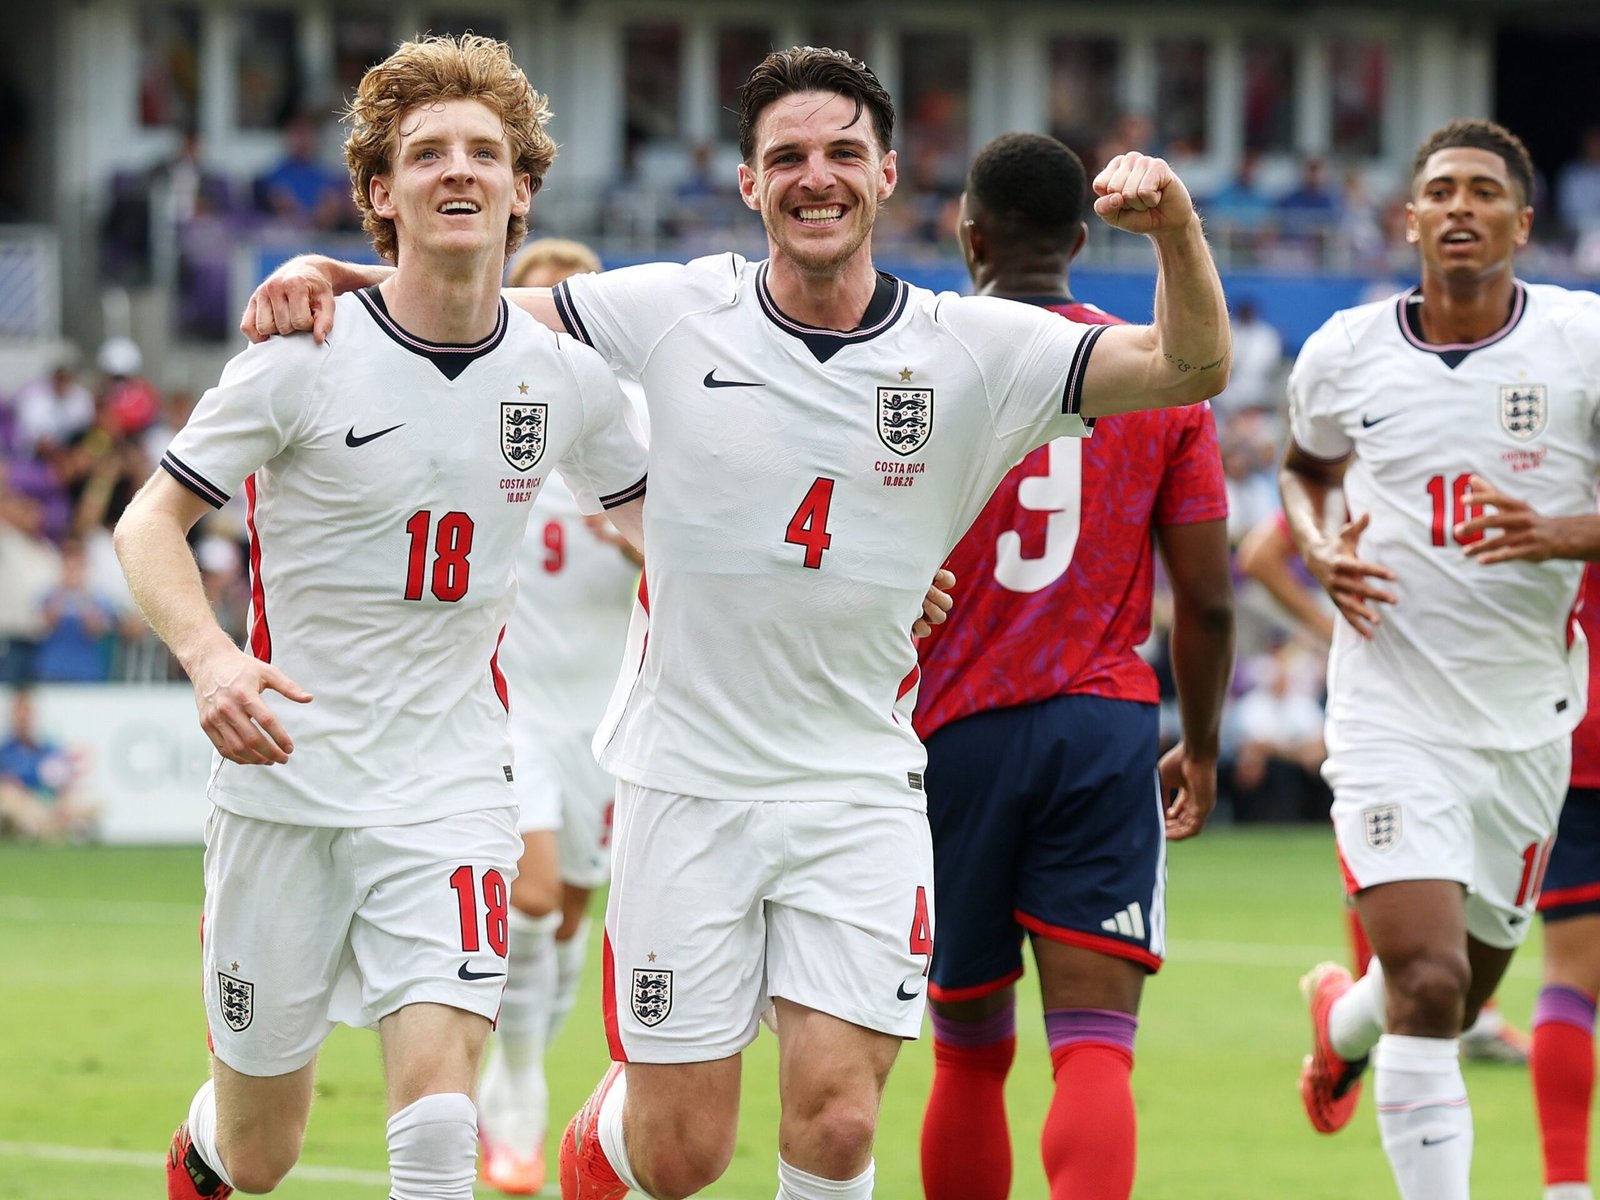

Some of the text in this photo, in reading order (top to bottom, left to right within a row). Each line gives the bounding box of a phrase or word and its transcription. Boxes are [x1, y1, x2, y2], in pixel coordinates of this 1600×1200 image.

[499, 477, 541, 490] COSTA RICA
[874, 460, 926, 474] COSTA RICA
[883, 475, 914, 487] 10.06.26
[404, 510, 475, 603] 18
[542, 520, 566, 577] 9
[784, 476, 835, 570] 4
[449, 865, 508, 959] 18
[909, 885, 932, 977] 4
